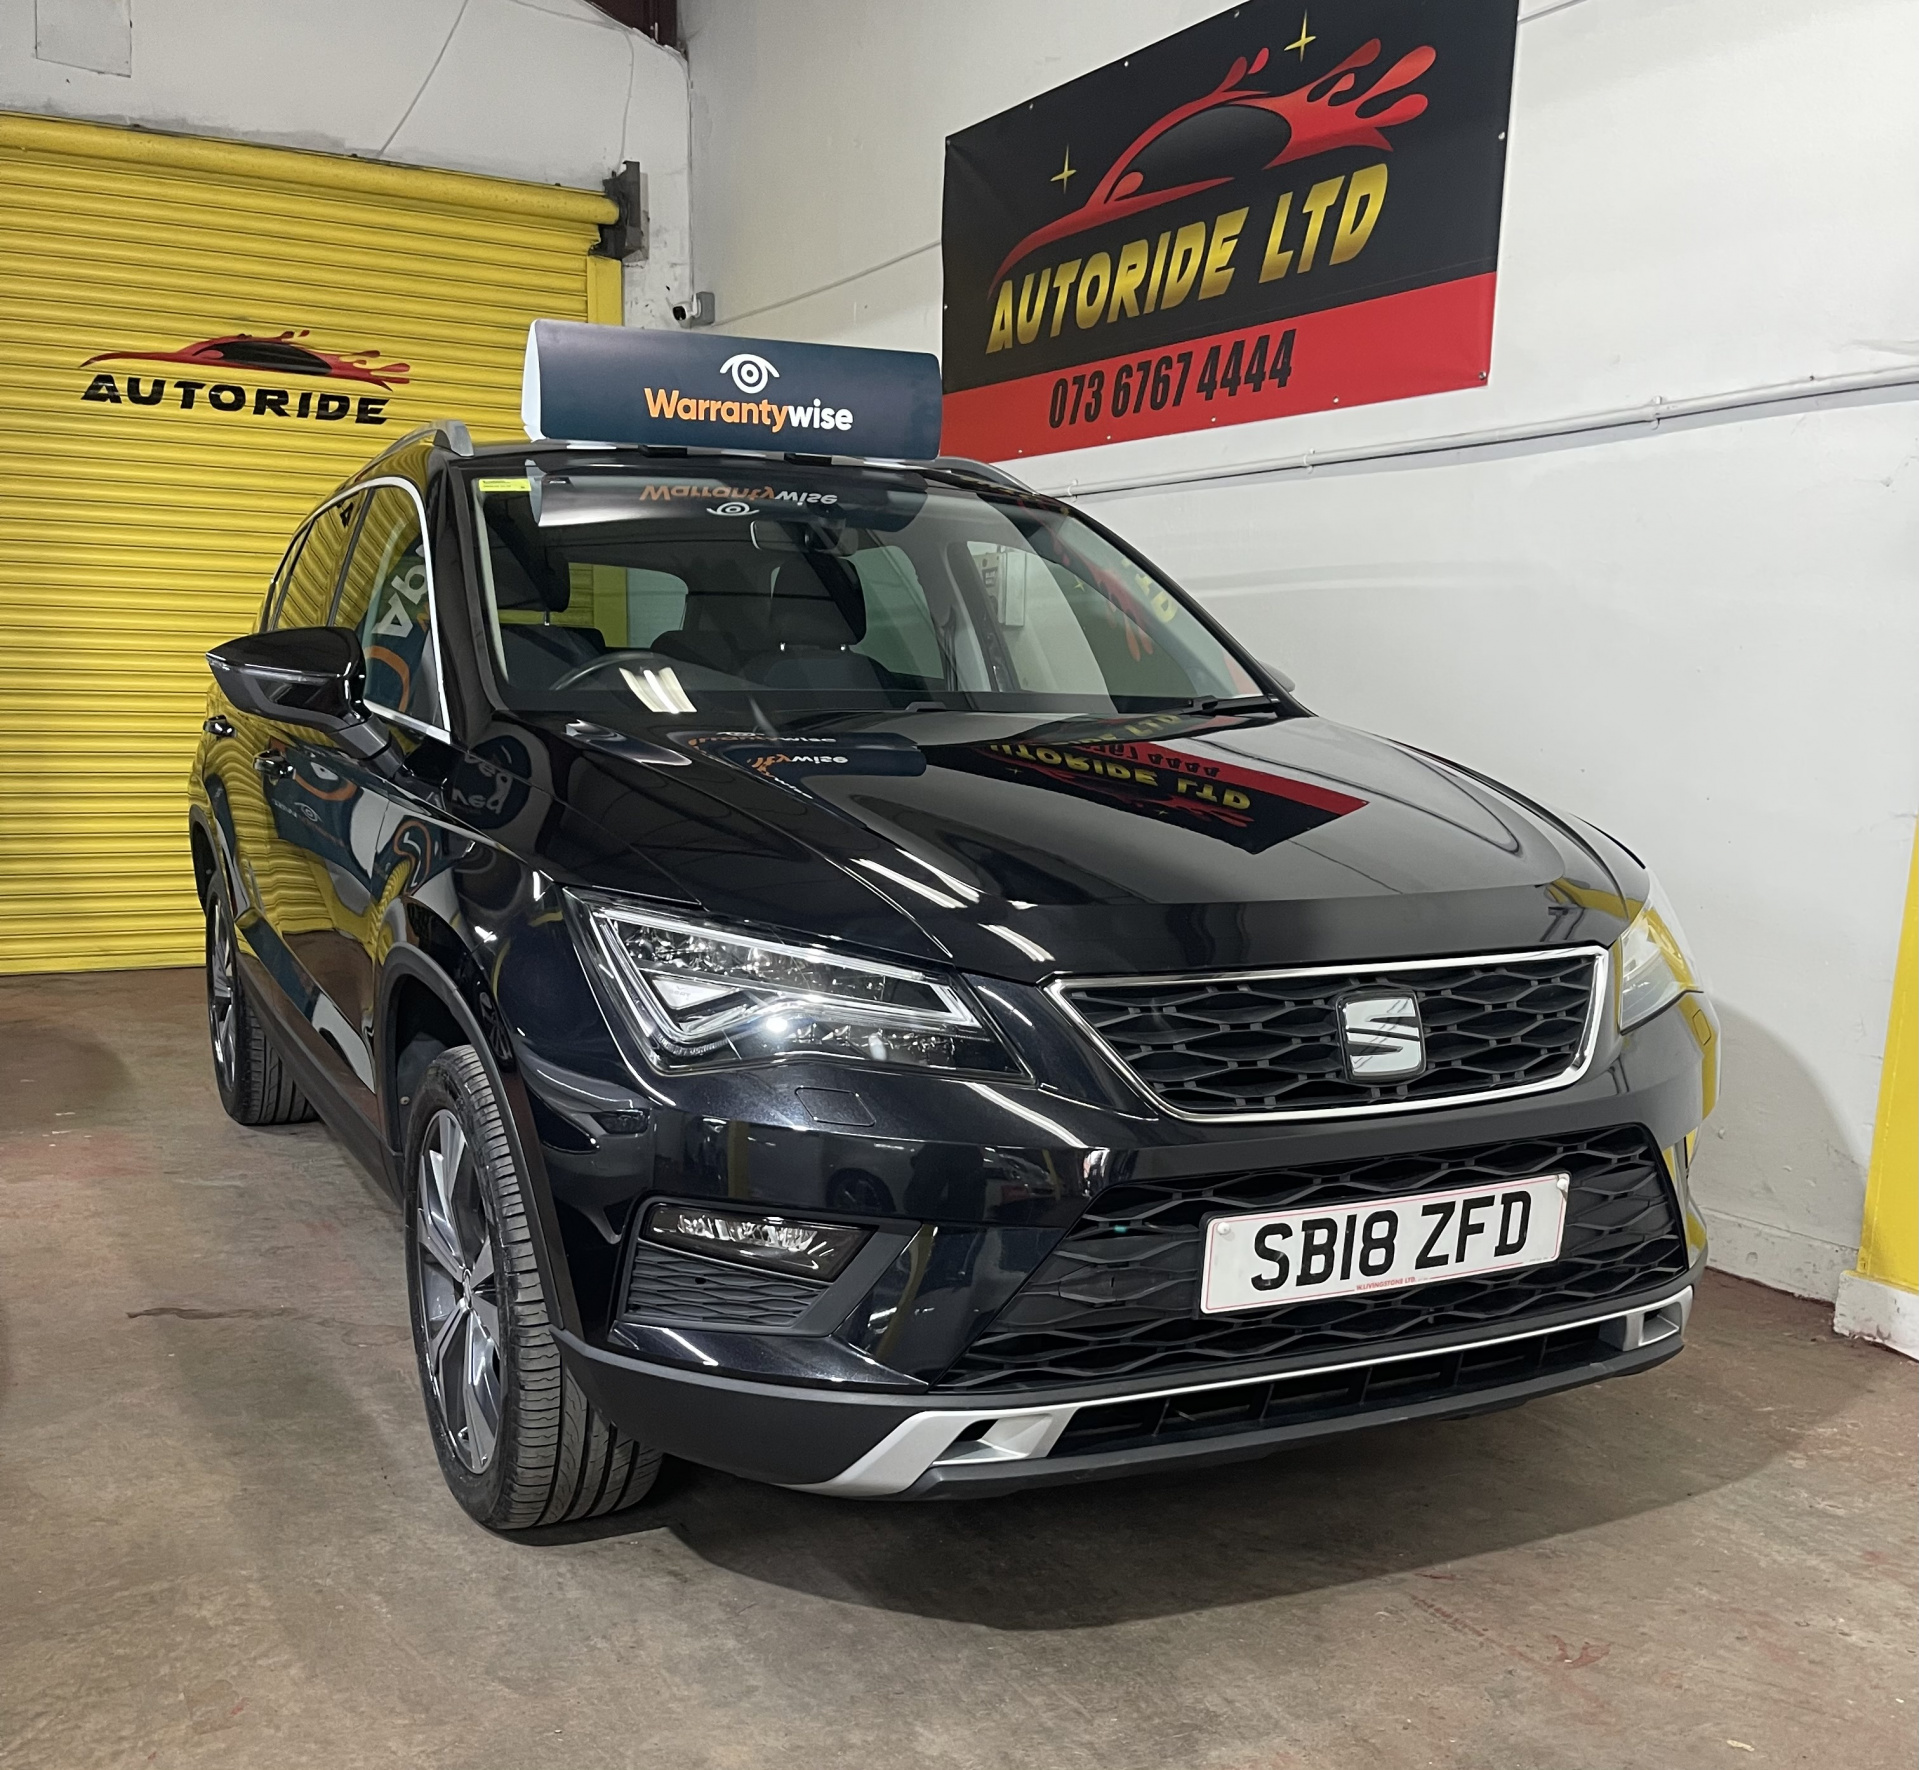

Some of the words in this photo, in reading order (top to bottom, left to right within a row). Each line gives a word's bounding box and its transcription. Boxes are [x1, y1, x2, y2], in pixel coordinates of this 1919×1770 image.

[985, 206, 1249, 355] AUTORIDE
[1258, 163, 1388, 283] LTD
[81, 374, 390, 424] AUTORIDE
[644, 388, 854, 432] Warrantywise
[1049, 370, 1105, 429] 073
[1111, 351, 1193, 418] 6767
[1196, 329, 1297, 401] 4444
[1251, 1210, 1399, 1291] SB18
[1415, 1190, 1532, 1270] ZFD
